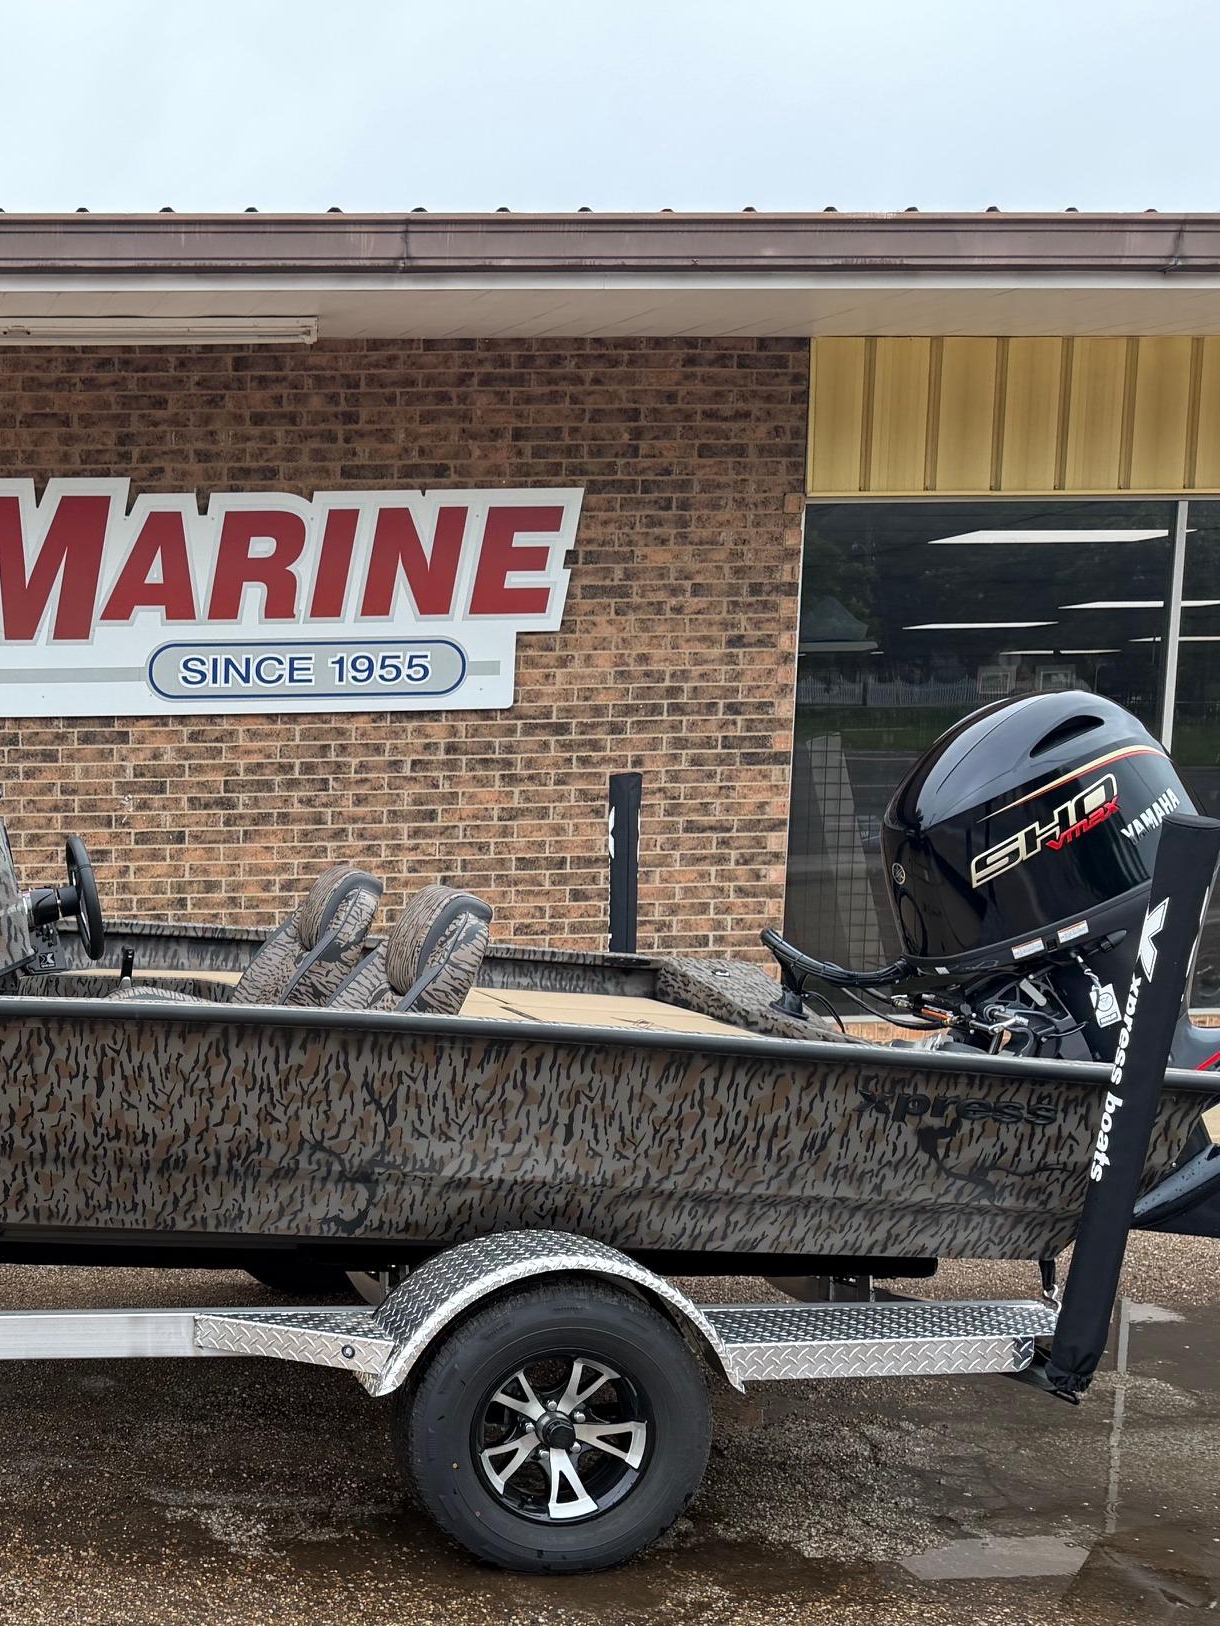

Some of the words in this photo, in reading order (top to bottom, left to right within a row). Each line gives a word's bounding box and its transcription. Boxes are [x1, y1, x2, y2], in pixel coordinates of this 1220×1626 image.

[180, 653, 315, 686] SINCE
[329, 652, 432, 684] 1955
[1120, 787, 1181, 846] YAMAHA
[1110, 971, 1142, 1086] xpress
[1090, 1090, 1124, 1183] boats
